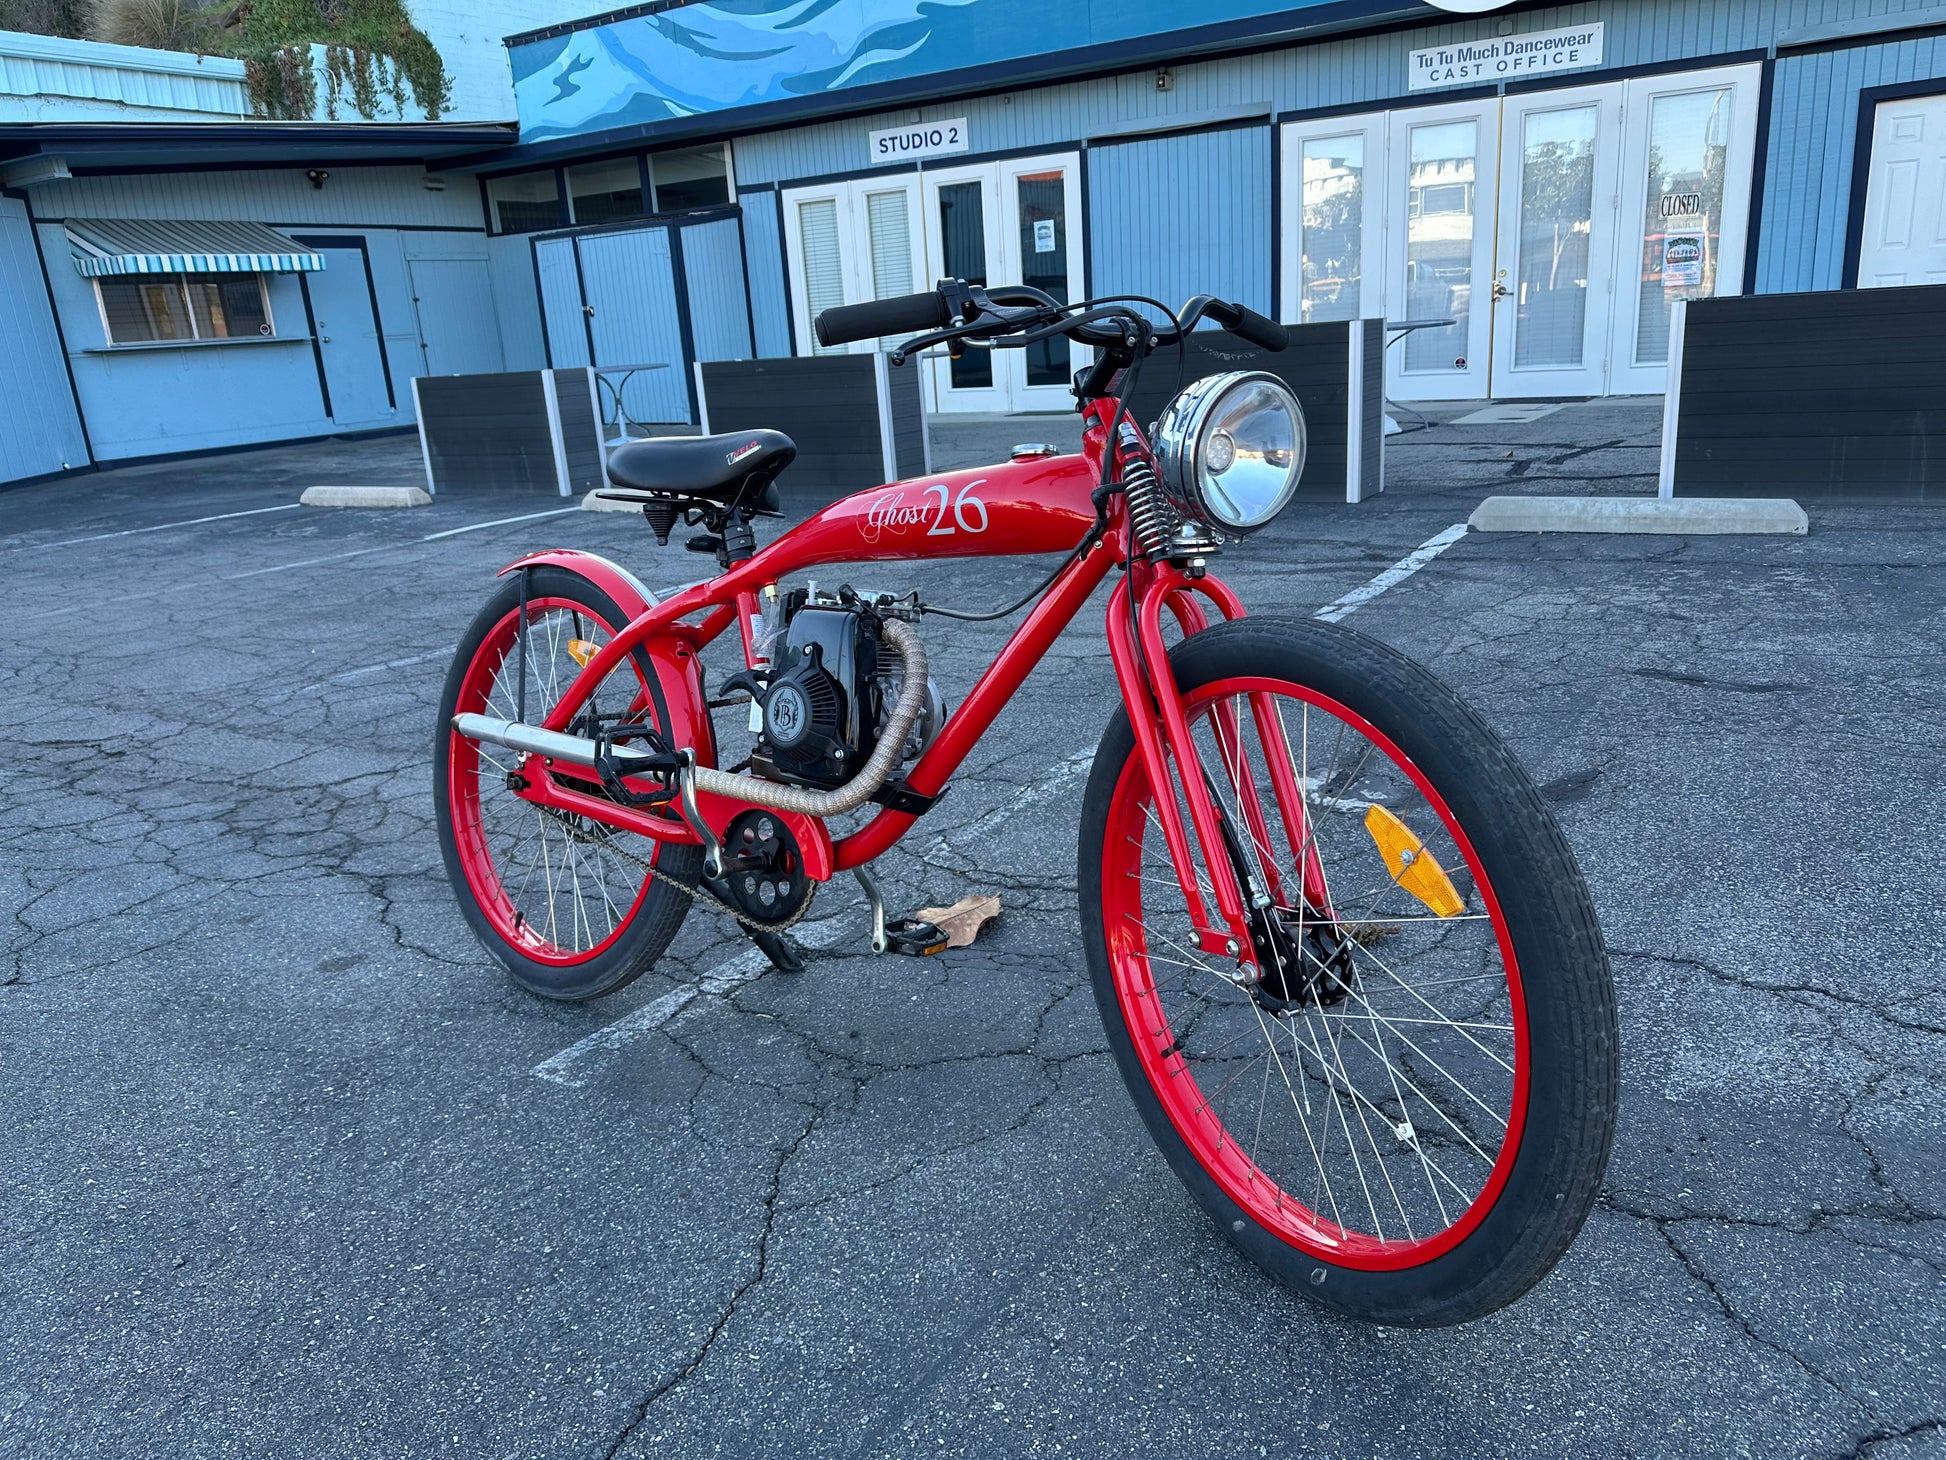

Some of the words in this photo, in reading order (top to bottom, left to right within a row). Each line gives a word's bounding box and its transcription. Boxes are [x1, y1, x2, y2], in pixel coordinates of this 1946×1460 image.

[1417, 54, 1433, 68] Tu
[1437, 51, 1453, 66] Tu
[1457, 44, 1500, 64] Much
[1504, 32, 1594, 56] Dancewear
[1430, 63, 1483, 81] CAST
[1496, 50, 1579, 72] OFFICE
[879, 130, 943, 154] STUDIO
[948, 127, 959, 144] 2
[1661, 194, 1700, 216] CLOSED
[856, 492, 933, 544] Ghost
[923, 479, 989, 537] 26
